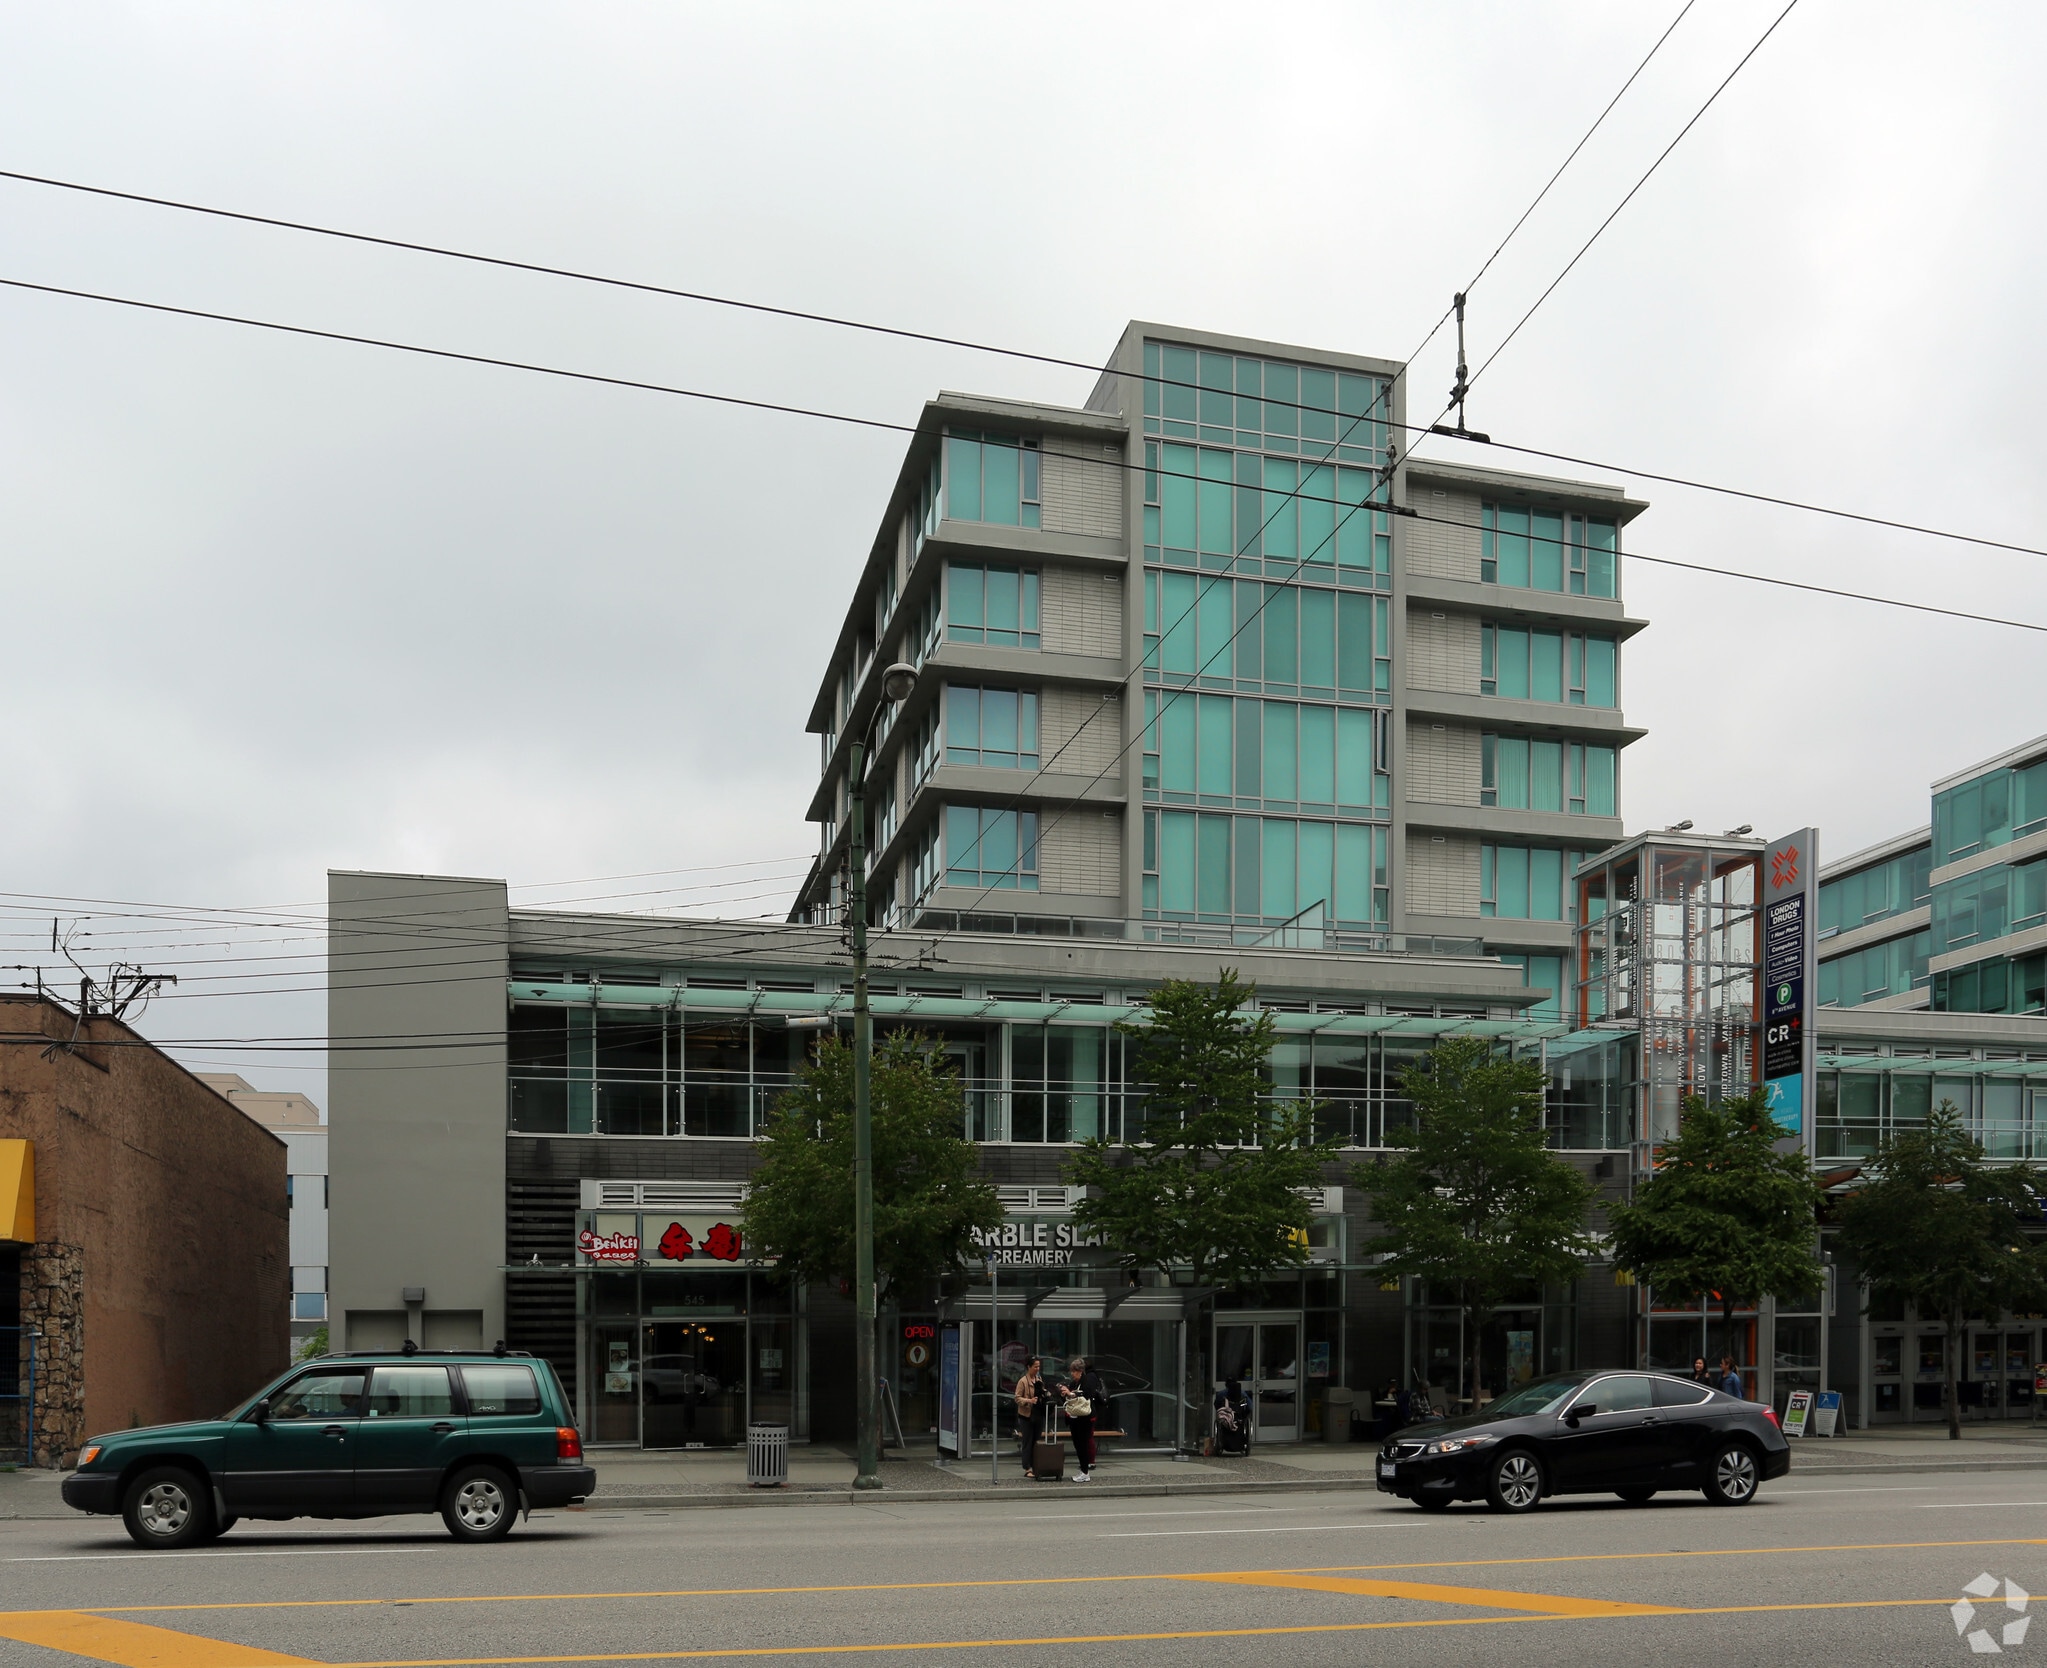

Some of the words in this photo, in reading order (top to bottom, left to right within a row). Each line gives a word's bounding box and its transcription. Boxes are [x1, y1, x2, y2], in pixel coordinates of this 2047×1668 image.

[1770, 900, 1800, 918] LONDON
[1772, 909, 1798, 925] DRUGS
[1772, 940, 1798, 953] Computers
[1781, 987, 1789, 1001] P
[1698, 1063, 1706, 1095] FLOW
[969, 1223, 1048, 1247] ARBLE
[581, 1234, 638, 1252] BENKEI
[993, 1249, 1074, 1264] CREAMERY
[684, 1295, 705, 1305] 545
[904, 1325, 935, 1338] OPEN
